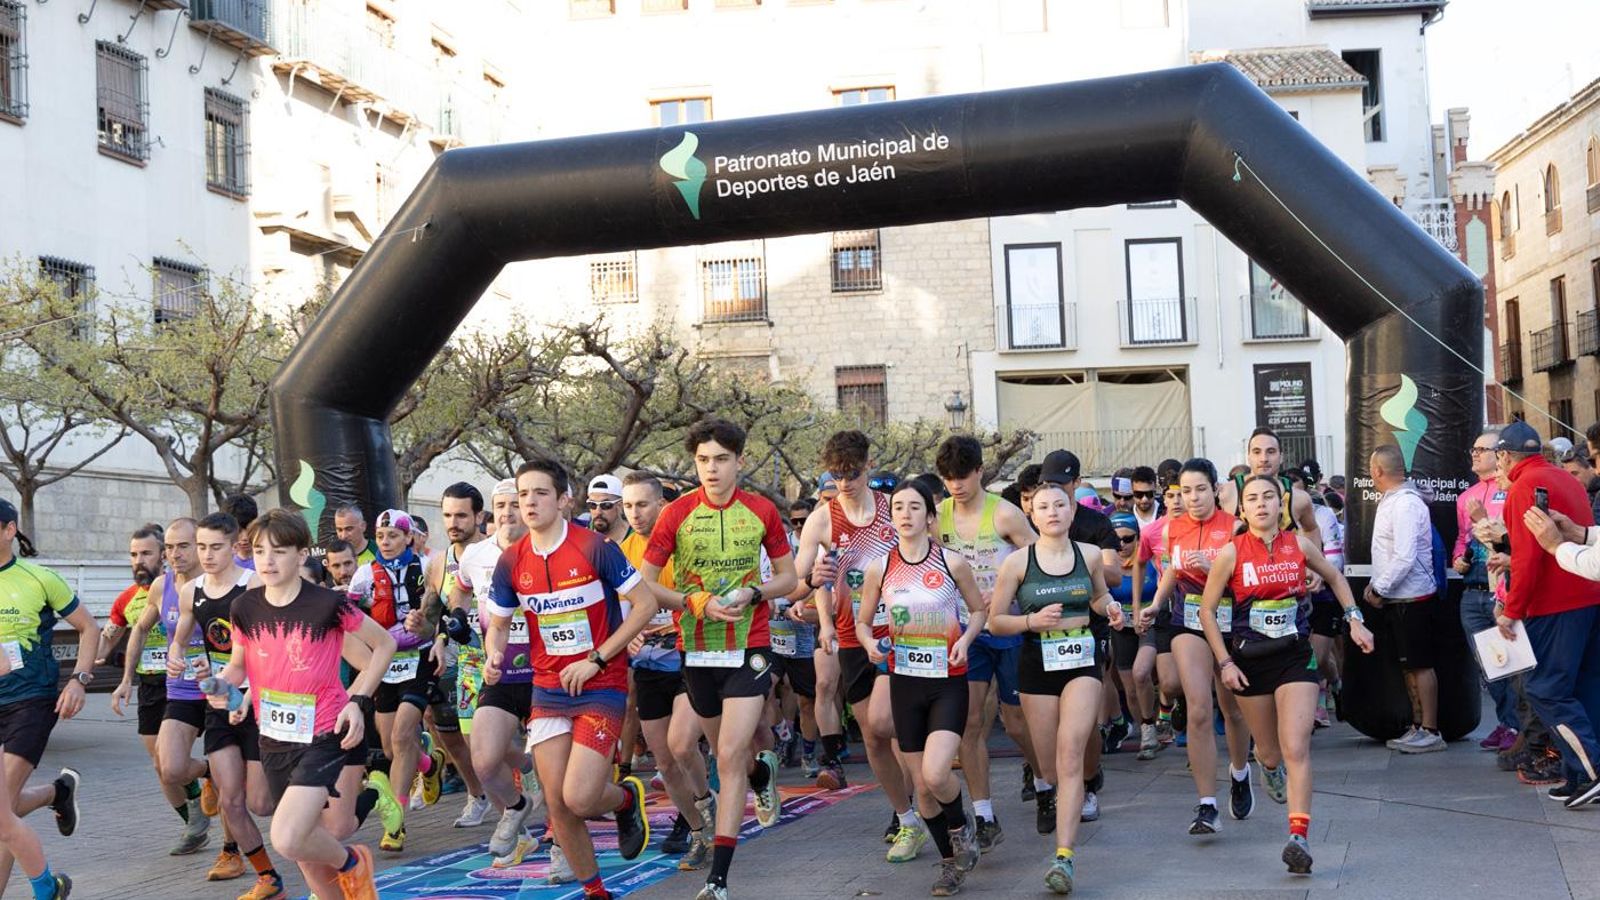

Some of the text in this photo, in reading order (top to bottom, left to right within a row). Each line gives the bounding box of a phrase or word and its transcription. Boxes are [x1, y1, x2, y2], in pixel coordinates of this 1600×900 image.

[714, 132, 949, 174] Patronato Municipal de
[716, 162, 896, 198] Deportes de Jaén
[1353, 478, 1374, 488] Patro
[1458, 479, 1470, 489] de
[1434, 490, 1458, 501] Jaén
[543, 596, 585, 610] Avanza
[1265, 614, 1287, 625] 652
[510, 622, 525, 631] 37
[552, 629, 575, 642] 653
[1058, 643, 1082, 655] 649
[908, 652, 932, 663] 620
[390, 663, 409, 673] 464
[271, 710, 296, 725] 619
